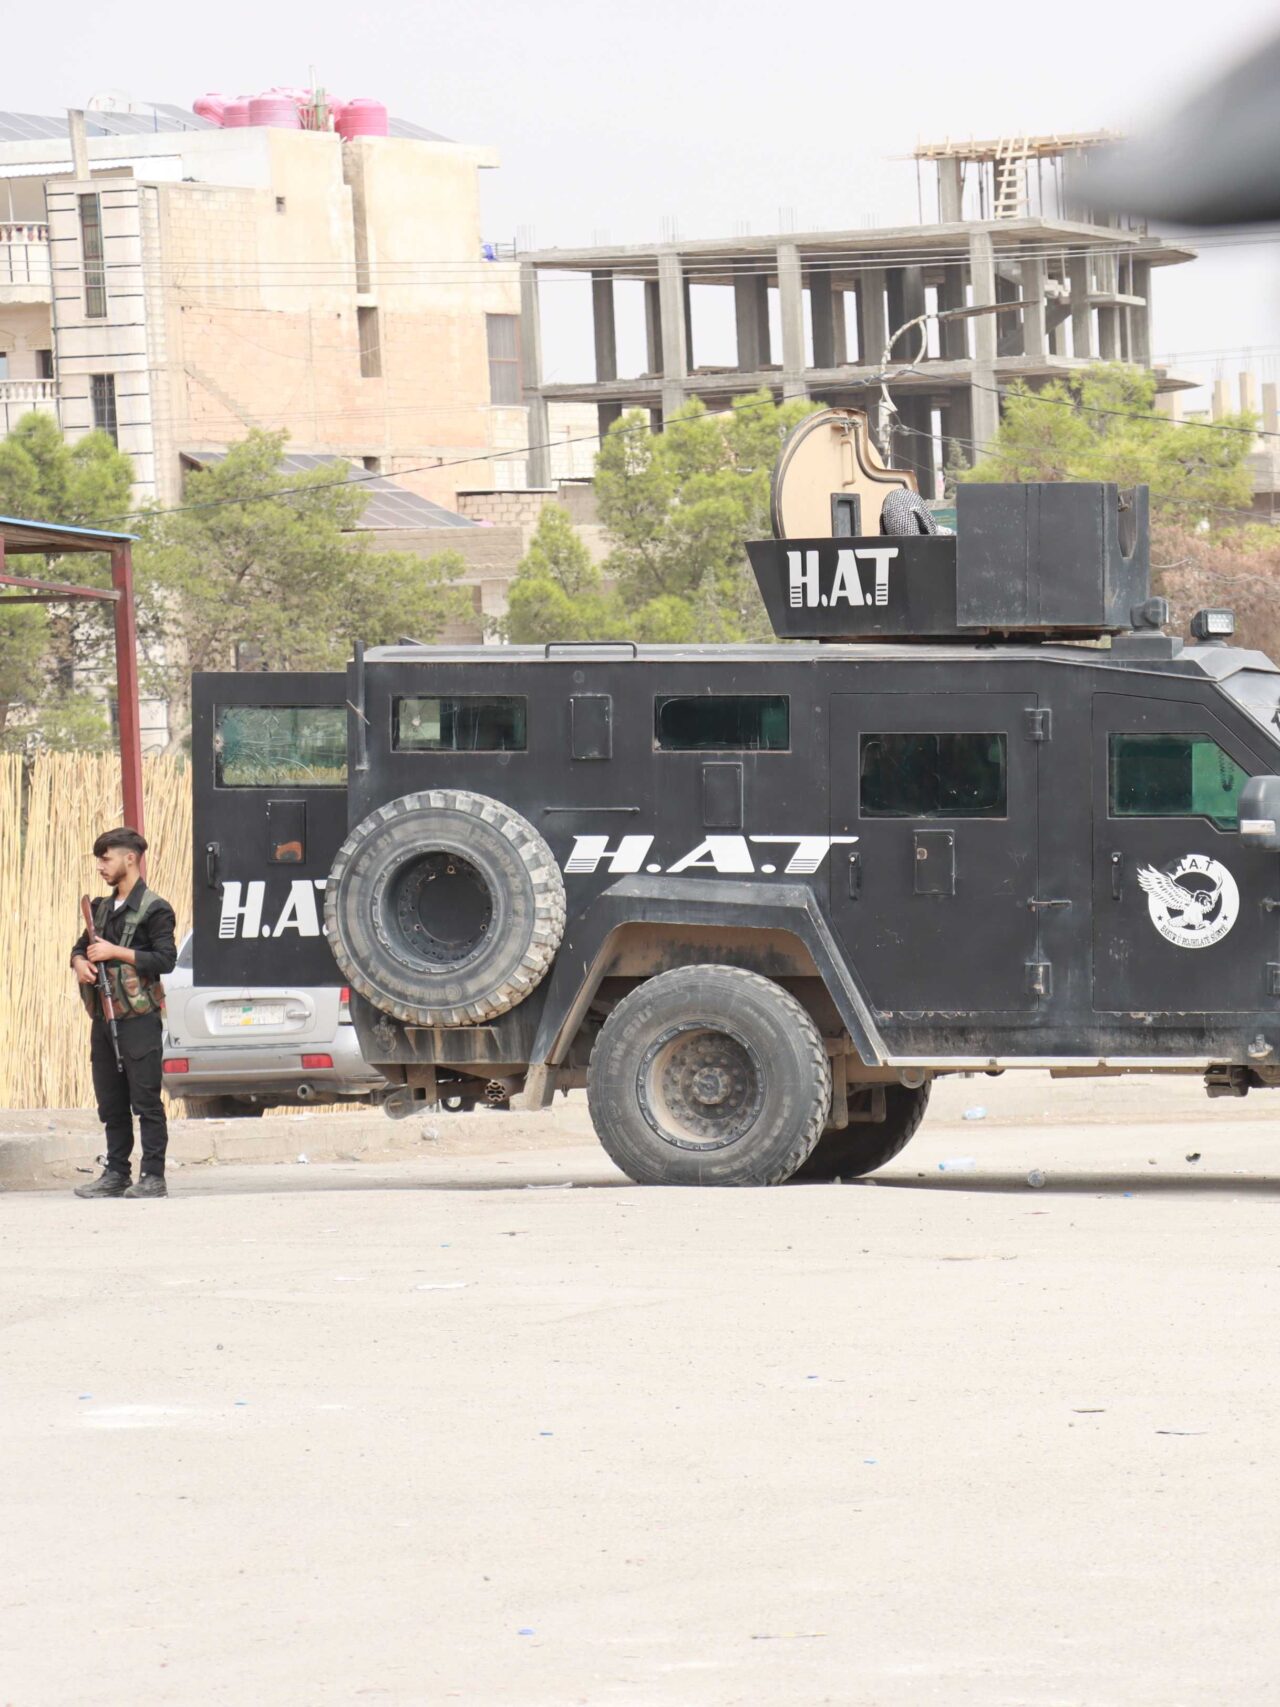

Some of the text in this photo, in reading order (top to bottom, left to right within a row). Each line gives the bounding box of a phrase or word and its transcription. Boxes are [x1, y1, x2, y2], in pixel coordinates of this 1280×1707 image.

[787, 547, 899, 608] H.A.T
[564, 835, 860, 874] H.A.T
[218, 879, 330, 939] H.A.
